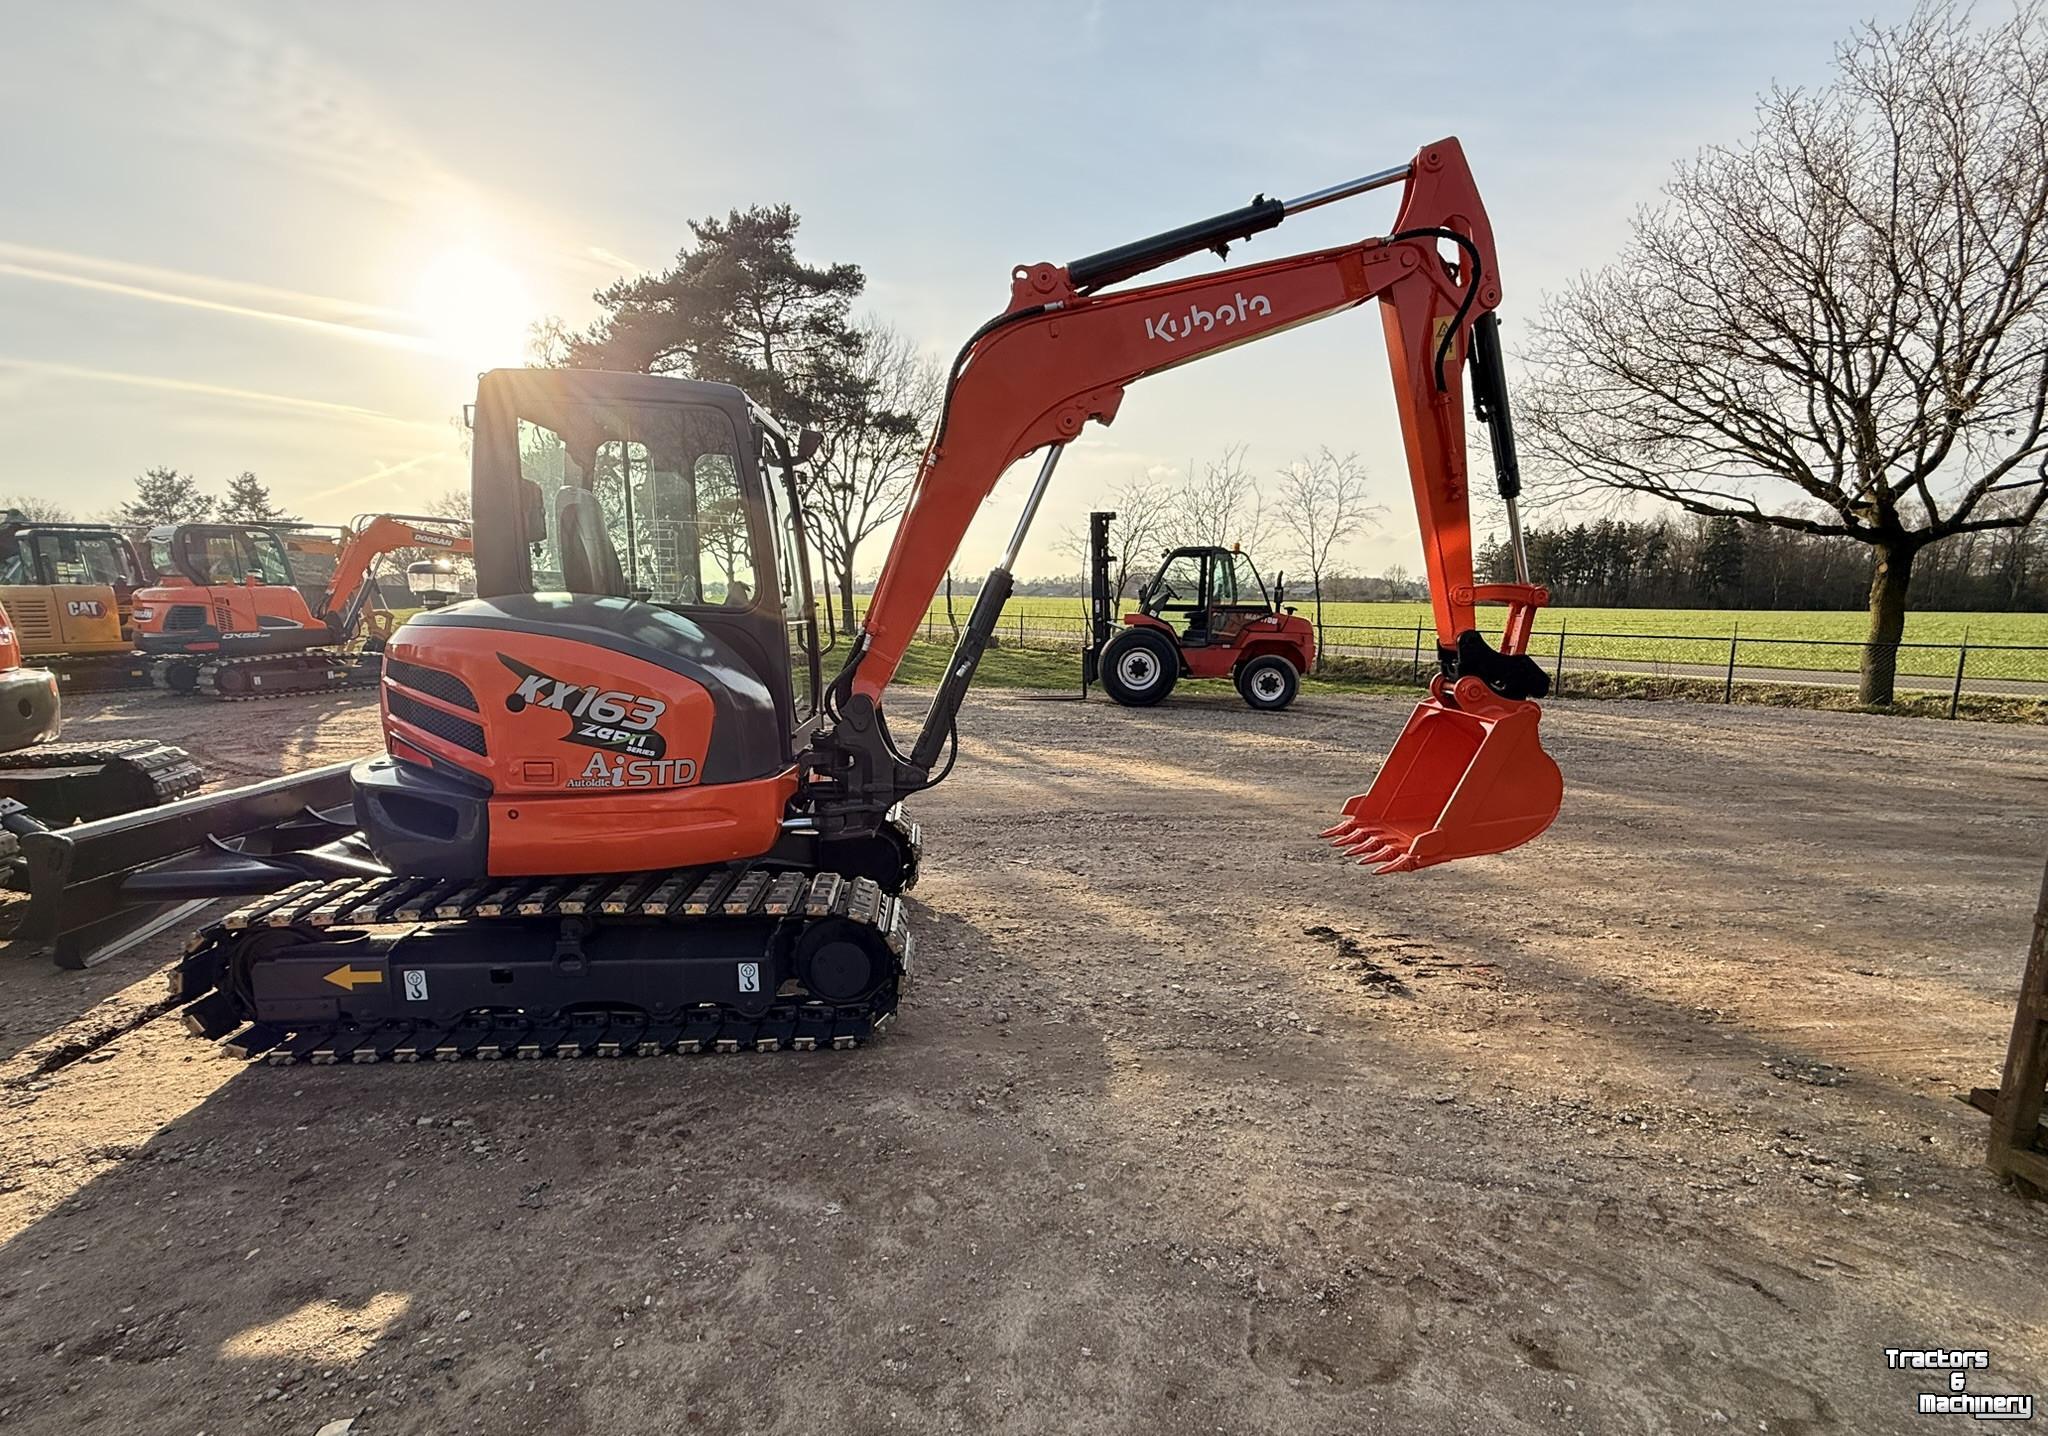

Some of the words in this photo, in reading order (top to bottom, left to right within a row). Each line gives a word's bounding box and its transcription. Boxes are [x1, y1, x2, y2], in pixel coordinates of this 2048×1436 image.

[1144, 292, 1272, 343] Kubota
[414, 534, 453, 546] DOOSAN
[66, 601, 100, 617] CAT
[514, 674, 666, 732] KX163
[625, 745, 656, 757] SERIES
